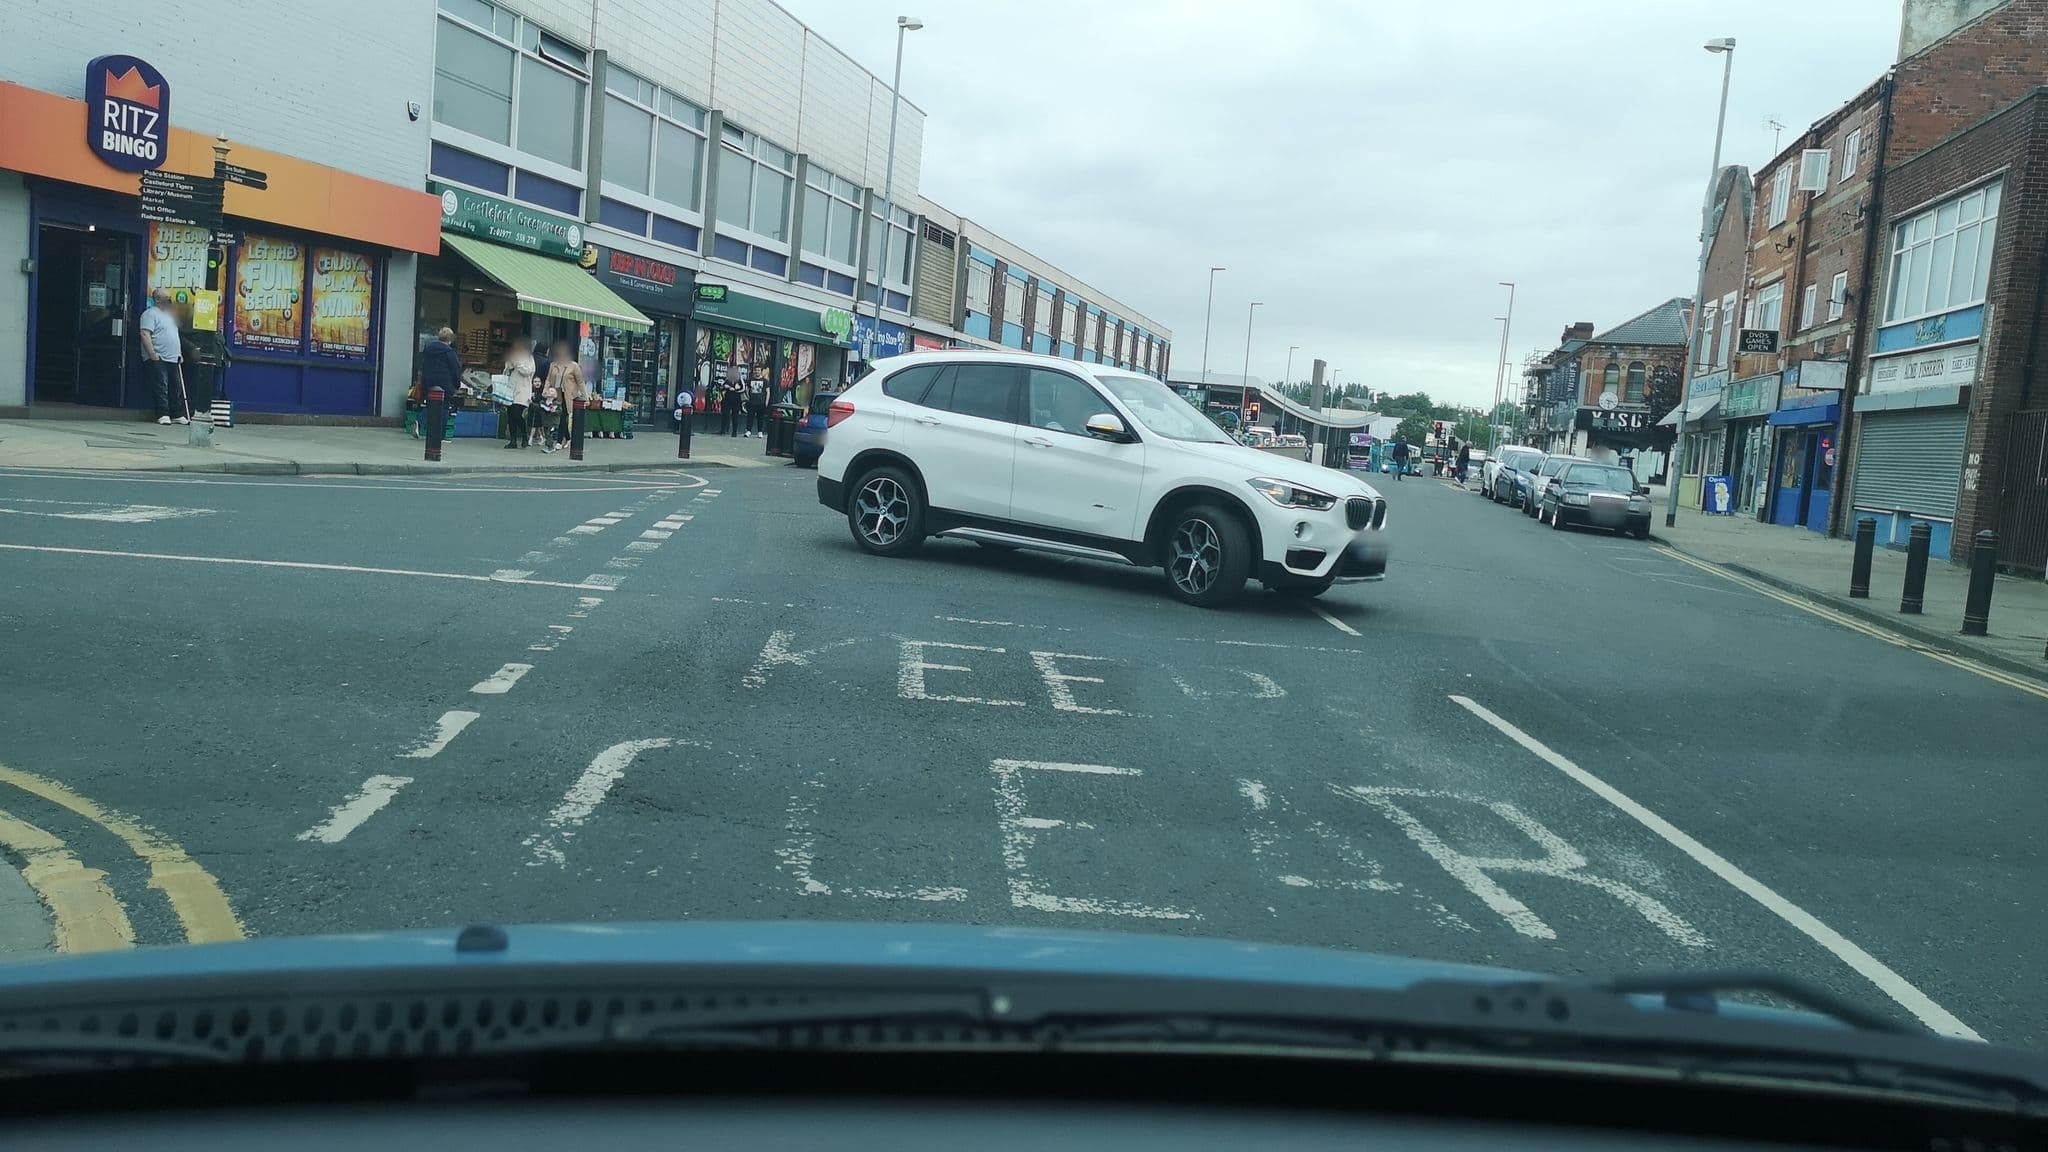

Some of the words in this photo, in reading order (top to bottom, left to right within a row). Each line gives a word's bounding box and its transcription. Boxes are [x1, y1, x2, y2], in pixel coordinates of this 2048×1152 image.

[104, 99, 159, 139] RITZ
[103, 130, 157, 160] BINGO
[143, 169, 162, 178] Police
[143, 178, 175, 187] Castleford
[143, 187, 193, 199] Library/Museum
[141, 213, 164, 222] Railway
[165, 216, 187, 224] Station
[463, 197, 514, 222] Castleford
[158, 226, 182, 243] THE
[183, 229, 209, 244] GAM
[248, 243, 270, 260] LET
[271, 245, 297, 260] THE
[155, 262, 208, 289] HER
[247, 261, 294, 290] FUN
[610, 252, 633, 273] KEEP
[634, 257, 646, 276] IN
[647, 260, 677, 284] TOUCH
[245, 290, 292, 311] BEGIN!
[886, 333, 897, 346] Store
[1968, 453, 1980, 464] NO
[741, 630, 1290, 716] KEEP
